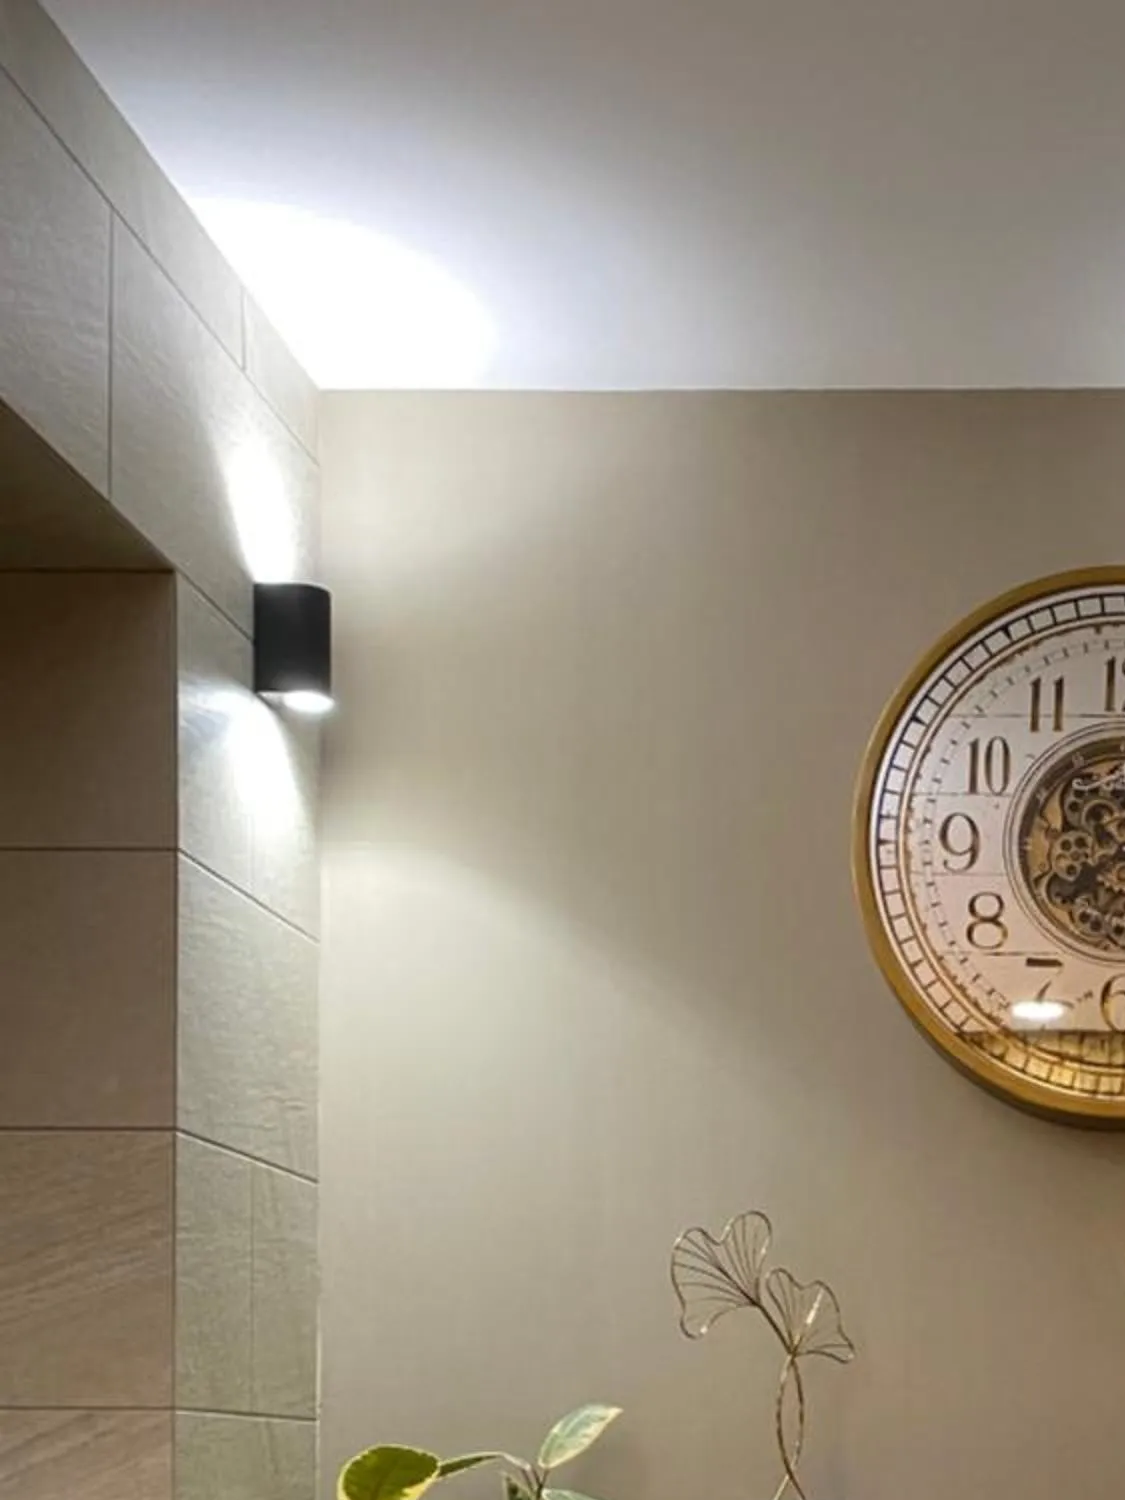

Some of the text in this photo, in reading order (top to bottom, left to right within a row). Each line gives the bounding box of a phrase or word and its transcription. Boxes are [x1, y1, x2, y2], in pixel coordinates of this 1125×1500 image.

[1029, 676, 1064, 733] 11
[967, 736, 1011, 795] 10
[938, 812, 980, 873] 9
[965, 892, 1007, 951] 8
